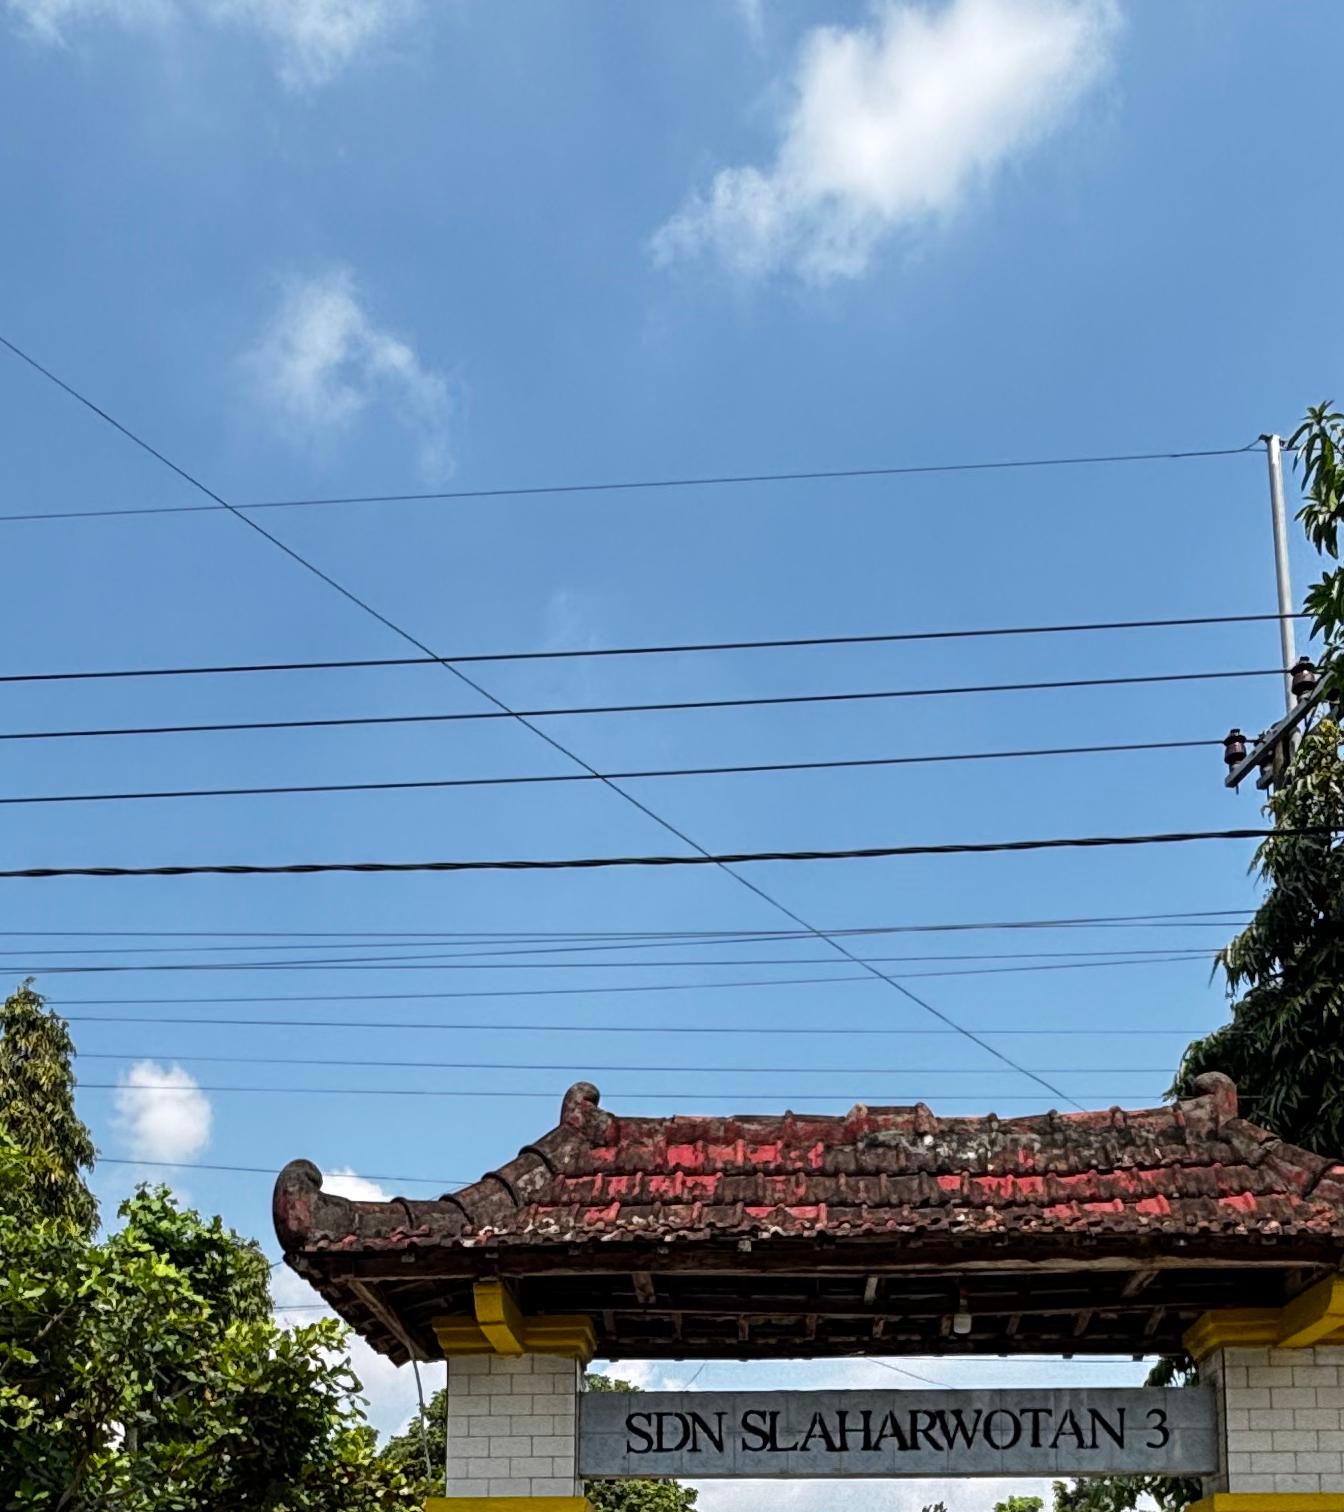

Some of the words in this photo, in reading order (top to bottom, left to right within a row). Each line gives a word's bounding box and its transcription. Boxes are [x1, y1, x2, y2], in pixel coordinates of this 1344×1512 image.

[625, 1412, 727, 1454] SDN
[741, 1408, 1126, 1452] SLAHARWOTAN
[1145, 1408, 1170, 1450] 3
